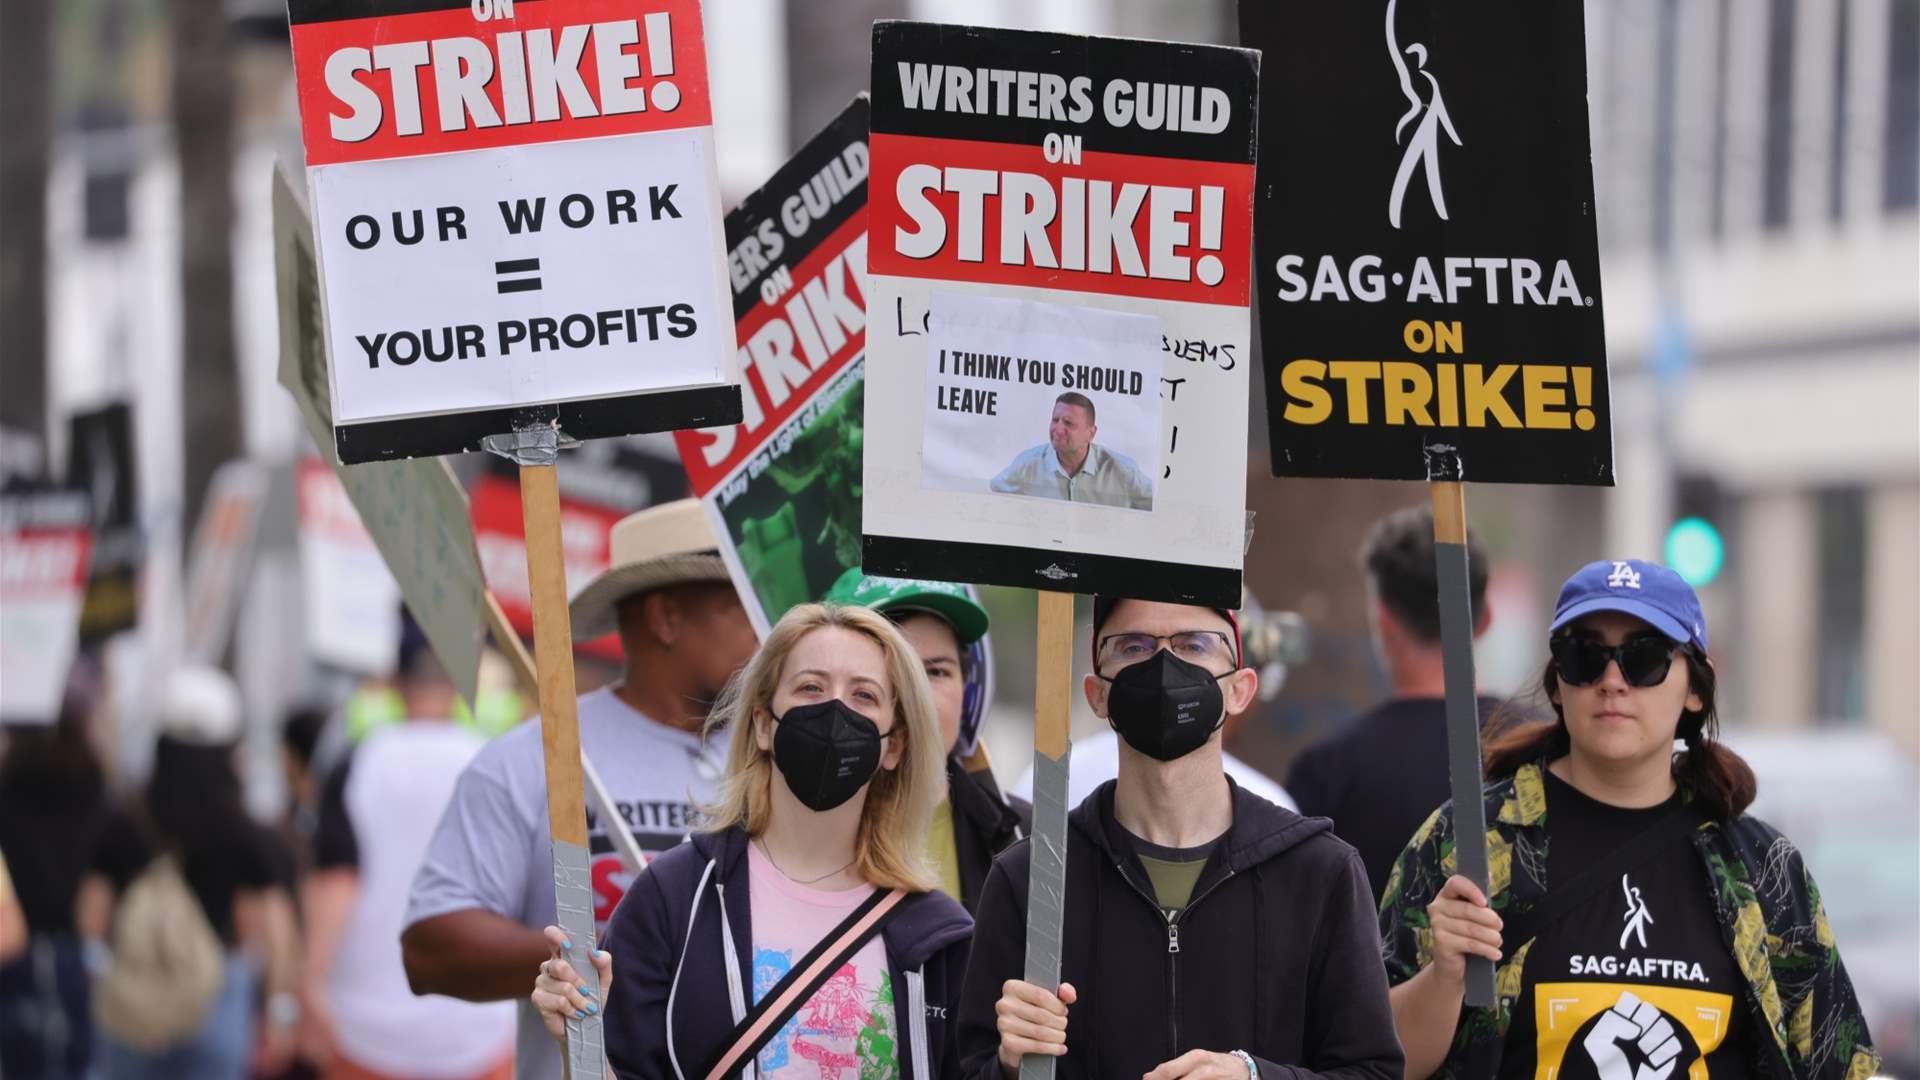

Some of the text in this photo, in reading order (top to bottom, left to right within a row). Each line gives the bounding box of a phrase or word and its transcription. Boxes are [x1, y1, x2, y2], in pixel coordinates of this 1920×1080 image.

[471, 0, 514, 22] ON
[324, 12, 682, 143] STRIKE!
[897, 62, 1231, 135] WRITERS GUILD
[1043, 132, 1082, 166] ON
[345, 184, 683, 250] OUR WORK
[728, 141, 869, 294] ERS GUILD
[895, 163, 1226, 287] STRIKE!
[760, 263, 794, 307] ON
[355, 303, 698, 369] YOUR PROFITS
[1403, 319, 1464, 355] ON
[939, 349, 1143, 396] I THINK YOU SHOULD
[1280, 359, 1596, 431] STRIKE!
[937, 386, 998, 416] LEAVE
[1608, 561, 1640, 589] LA
